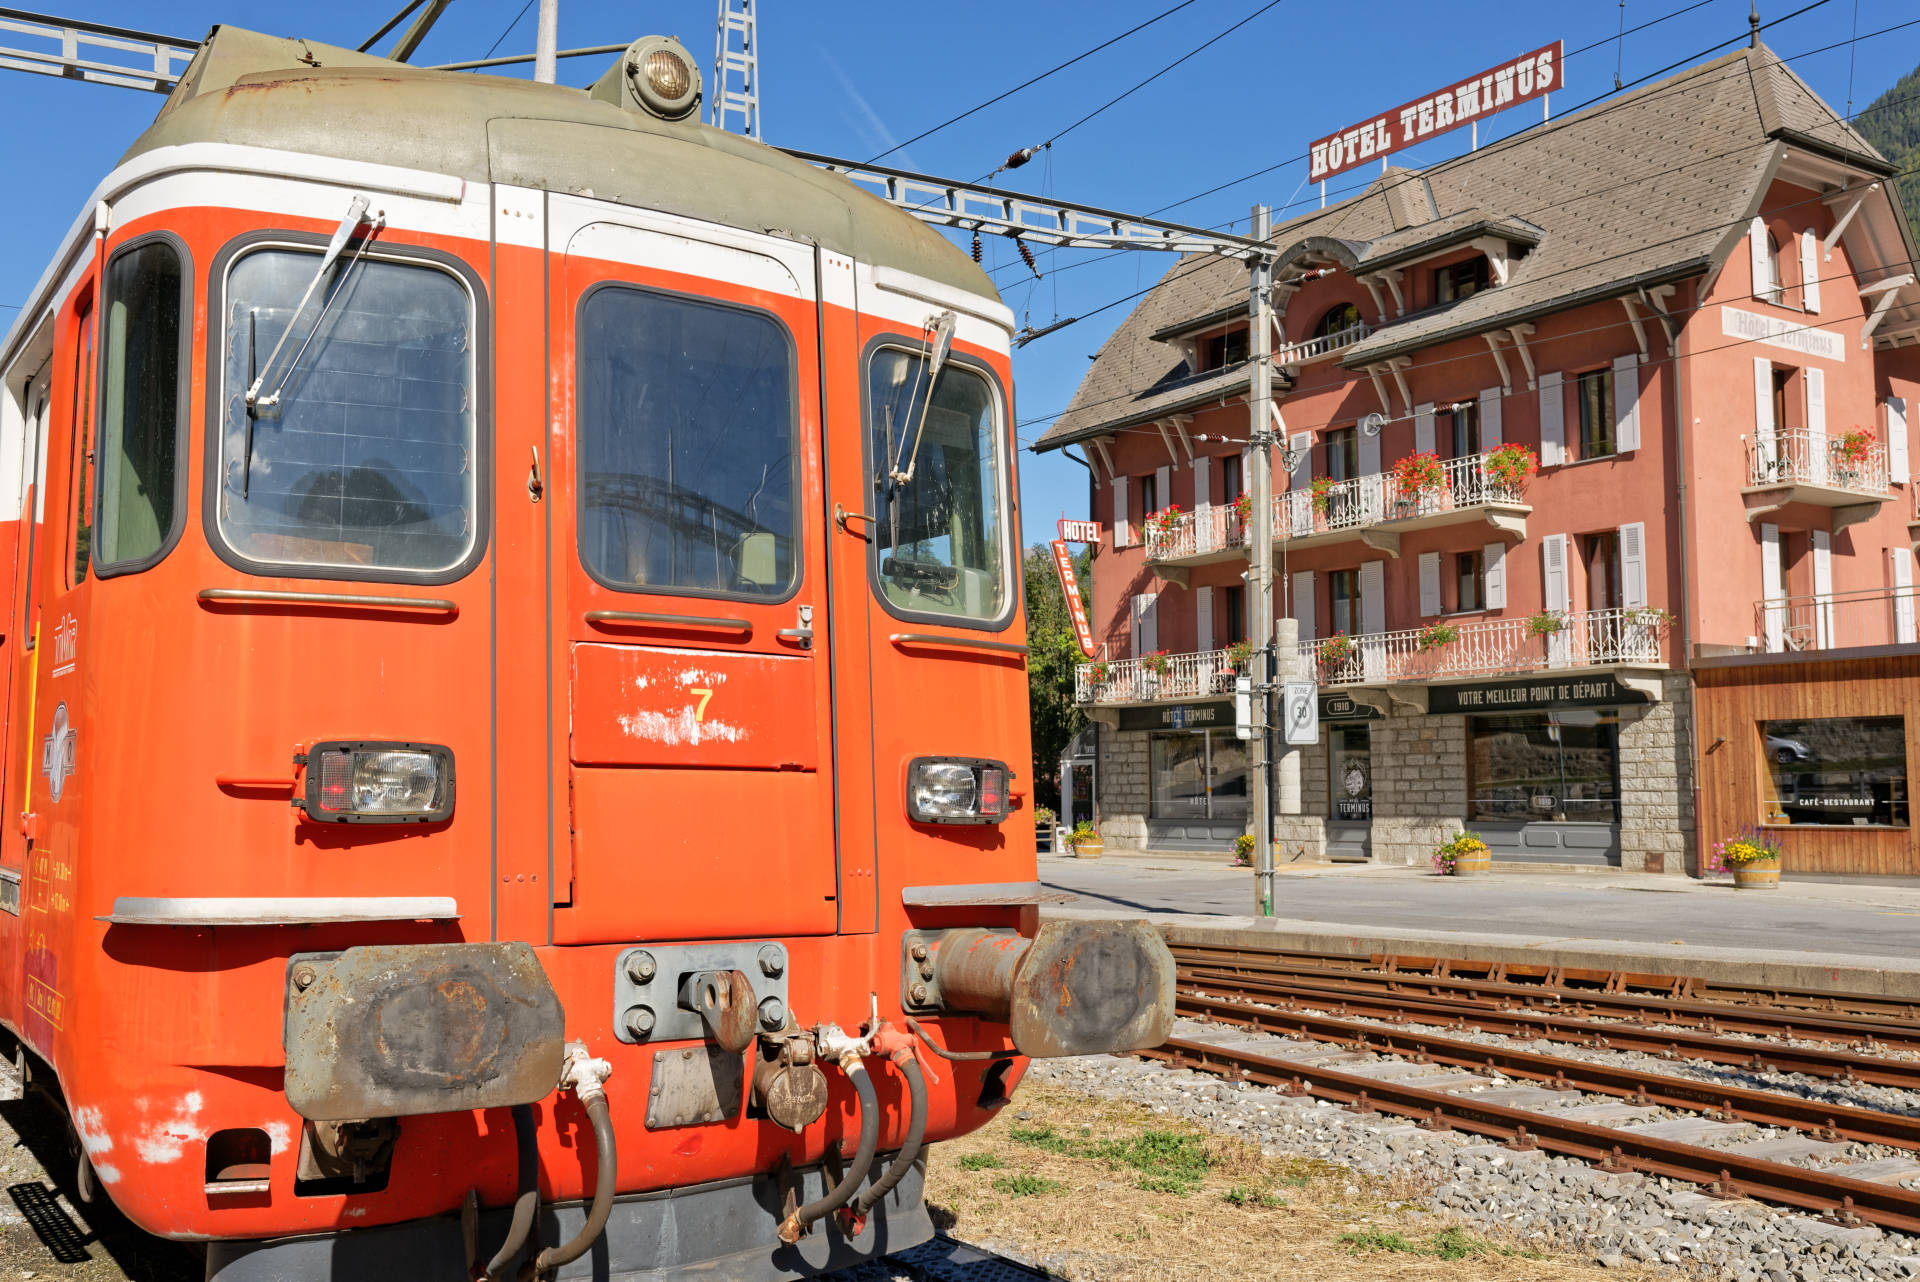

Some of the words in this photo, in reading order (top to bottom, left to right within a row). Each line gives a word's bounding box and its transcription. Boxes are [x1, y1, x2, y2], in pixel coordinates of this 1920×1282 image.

[1311, 118, 1391, 178] HOTEL
[1400, 50, 1554, 142] TERMINUS
[1064, 521, 1100, 542] HOTEL
[1056, 543, 1093, 649] TERMINUS
[1295, 686, 1309, 695] ZONE
[1458, 690, 1483, 705] VOTRE
[1486, 688, 1527, 704] MEILLEUR
[1530, 686, 1555, 702] POINT
[1558, 685, 1570, 700] DE
[1573, 681, 1608, 699] DÉPART
[690, 688, 713, 722] 7
[1334, 702, 1350, 712] 1910
[1184, 709, 1215, 721] TERMINUS
[1297, 706, 1307, 719] 30
[1339, 803, 1370, 813] TERMINUS
[1799, 797, 1875, 806] CAFÉ-RESTAURANT
